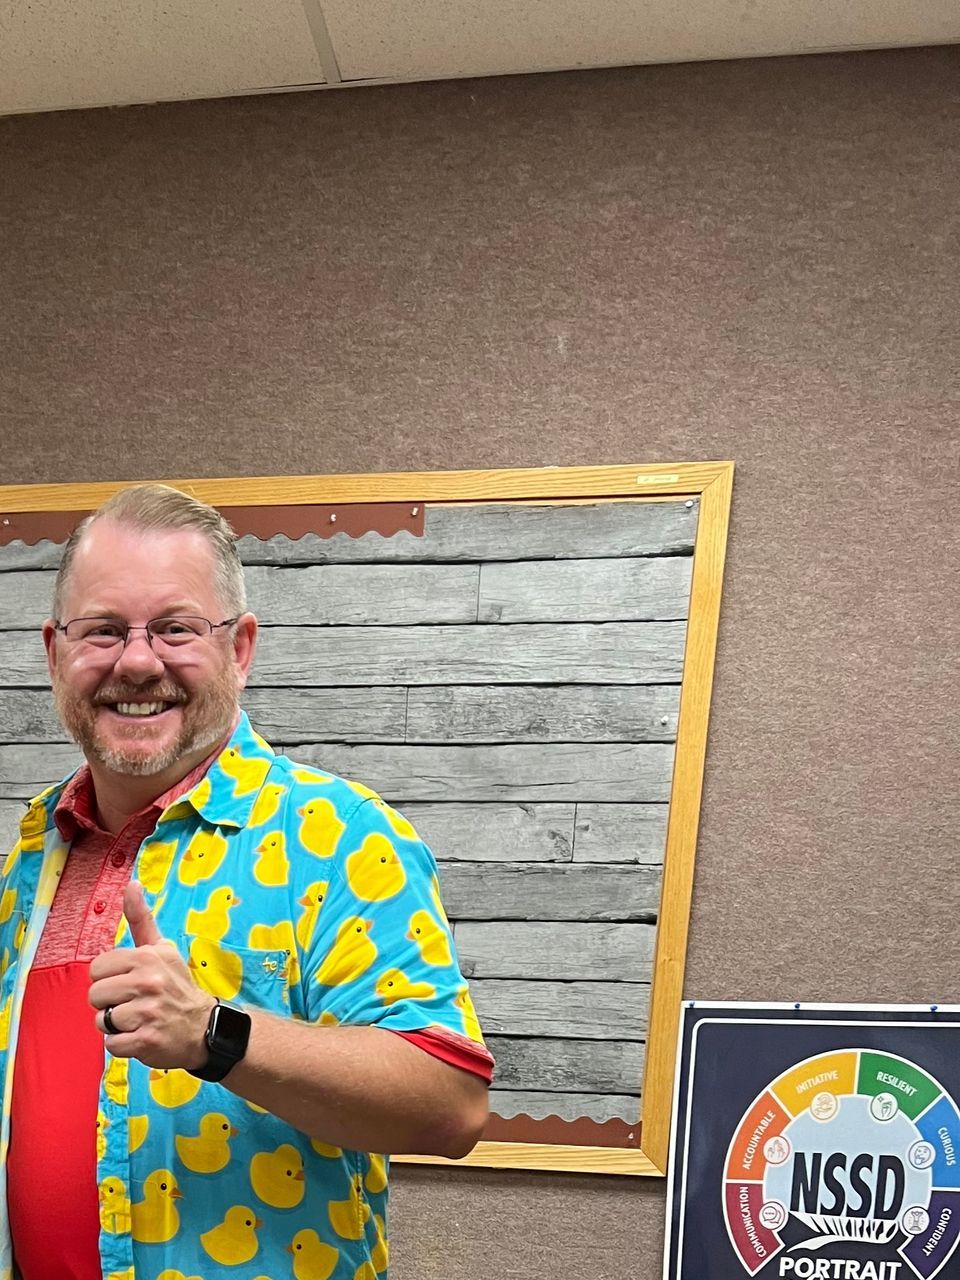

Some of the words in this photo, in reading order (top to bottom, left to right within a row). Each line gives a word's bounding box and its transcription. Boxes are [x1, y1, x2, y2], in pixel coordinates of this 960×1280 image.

[796, 1070, 839, 1094] INITIATIVE
[876, 1071, 918, 1097] RESILIENT
[741, 1111, 777, 1170] ACCOUNTABLE
[938, 1127, 956, 1166] CURIOUS
[790, 1152, 906, 1221] NSSD
[739, 1186, 767, 1258] COMMUNICATION
[922, 1208, 952, 1257] CONFIDENT
